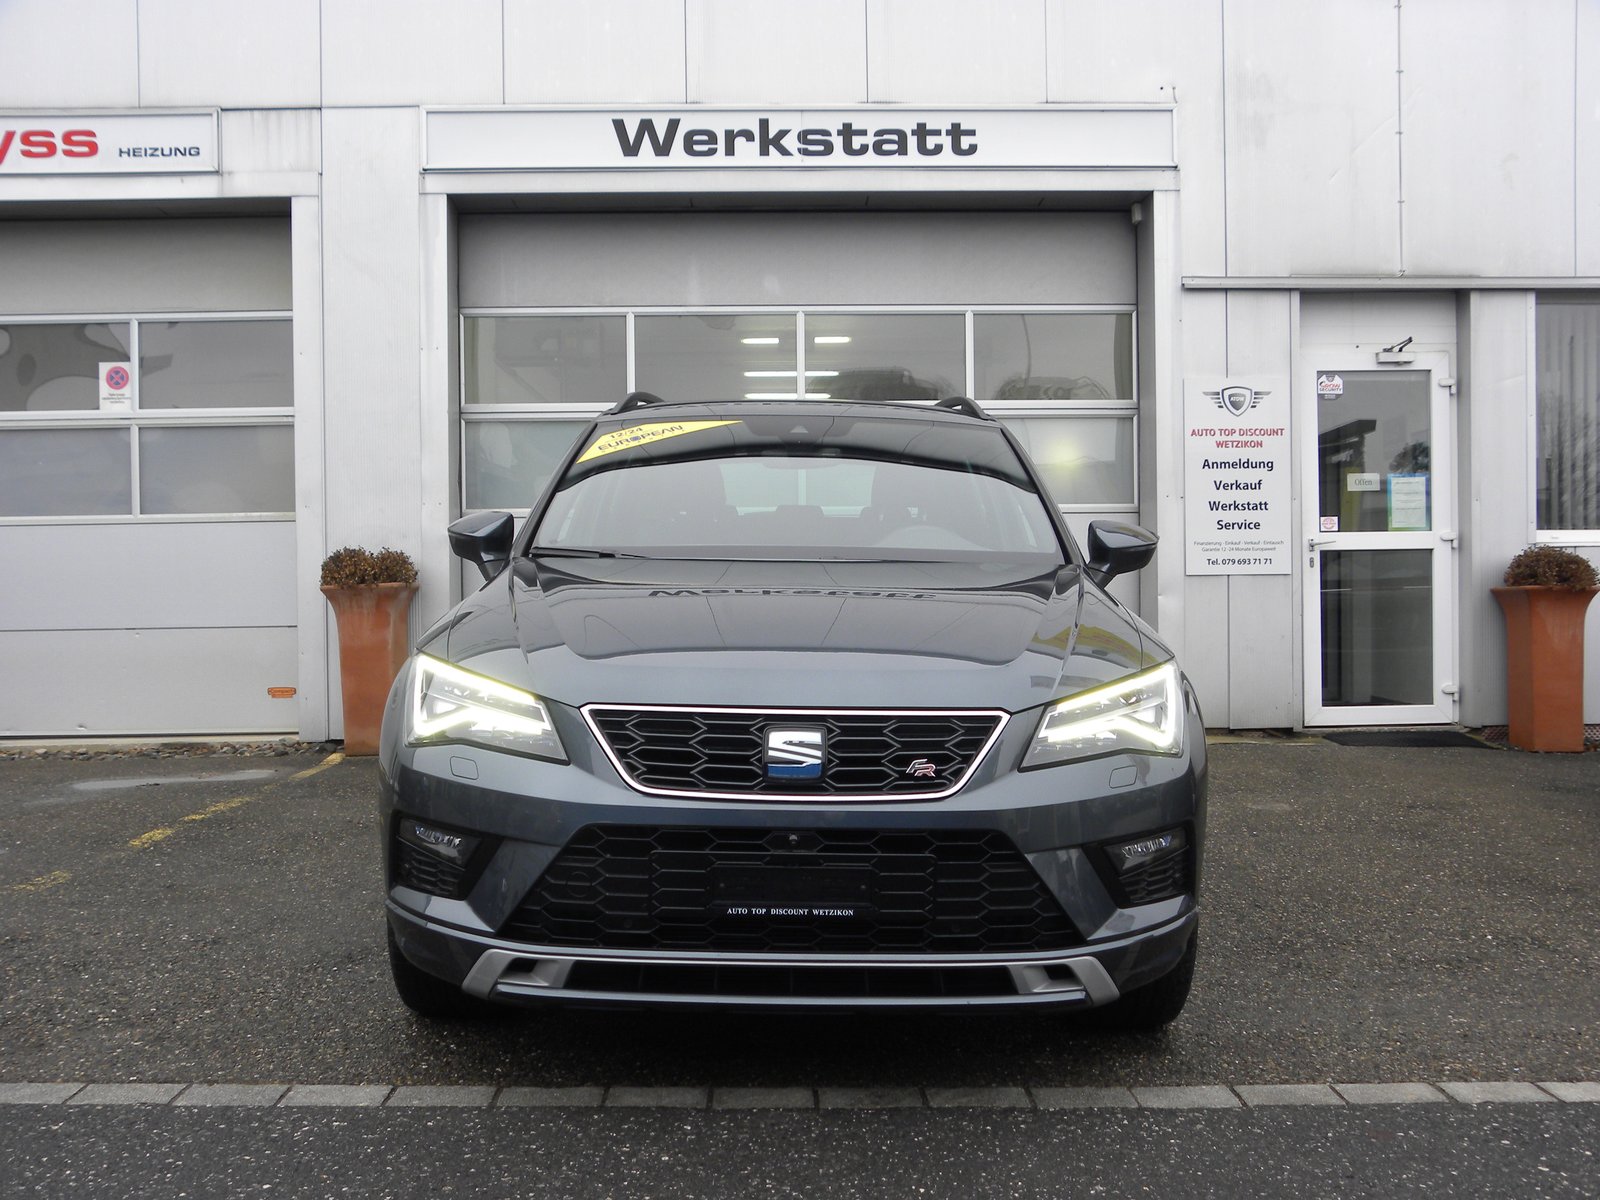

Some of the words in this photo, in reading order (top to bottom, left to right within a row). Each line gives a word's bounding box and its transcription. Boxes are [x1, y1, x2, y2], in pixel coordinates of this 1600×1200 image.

[611, 117, 978, 157] Werkstatt
[118, 146, 200, 158] HEIZUNG
[597, 424, 684, 451] EUROPEAN
[609, 427, 644, 439] 12/24
[1191, 428, 1216, 437] AUTO
[1218, 428, 1237, 437] TOP
[1238, 428, 1285, 437] DISCOUNT
[1215, 440, 1263, 449] WETZIKON
[1202, 458, 1274, 472] Anmeldung
[1213, 479, 1263, 491] Verkauf
[1208, 500, 1269, 511] Werkstatt
[1216, 519, 1261, 530] Service
[1207, 558, 1220, 566] Tel.
[1221, 558, 1236, 566] 079
[1237, 558, 1252, 566] 693
[905, 758, 936, 777] FR
[770, 908, 808, 916] DISCOUNT
